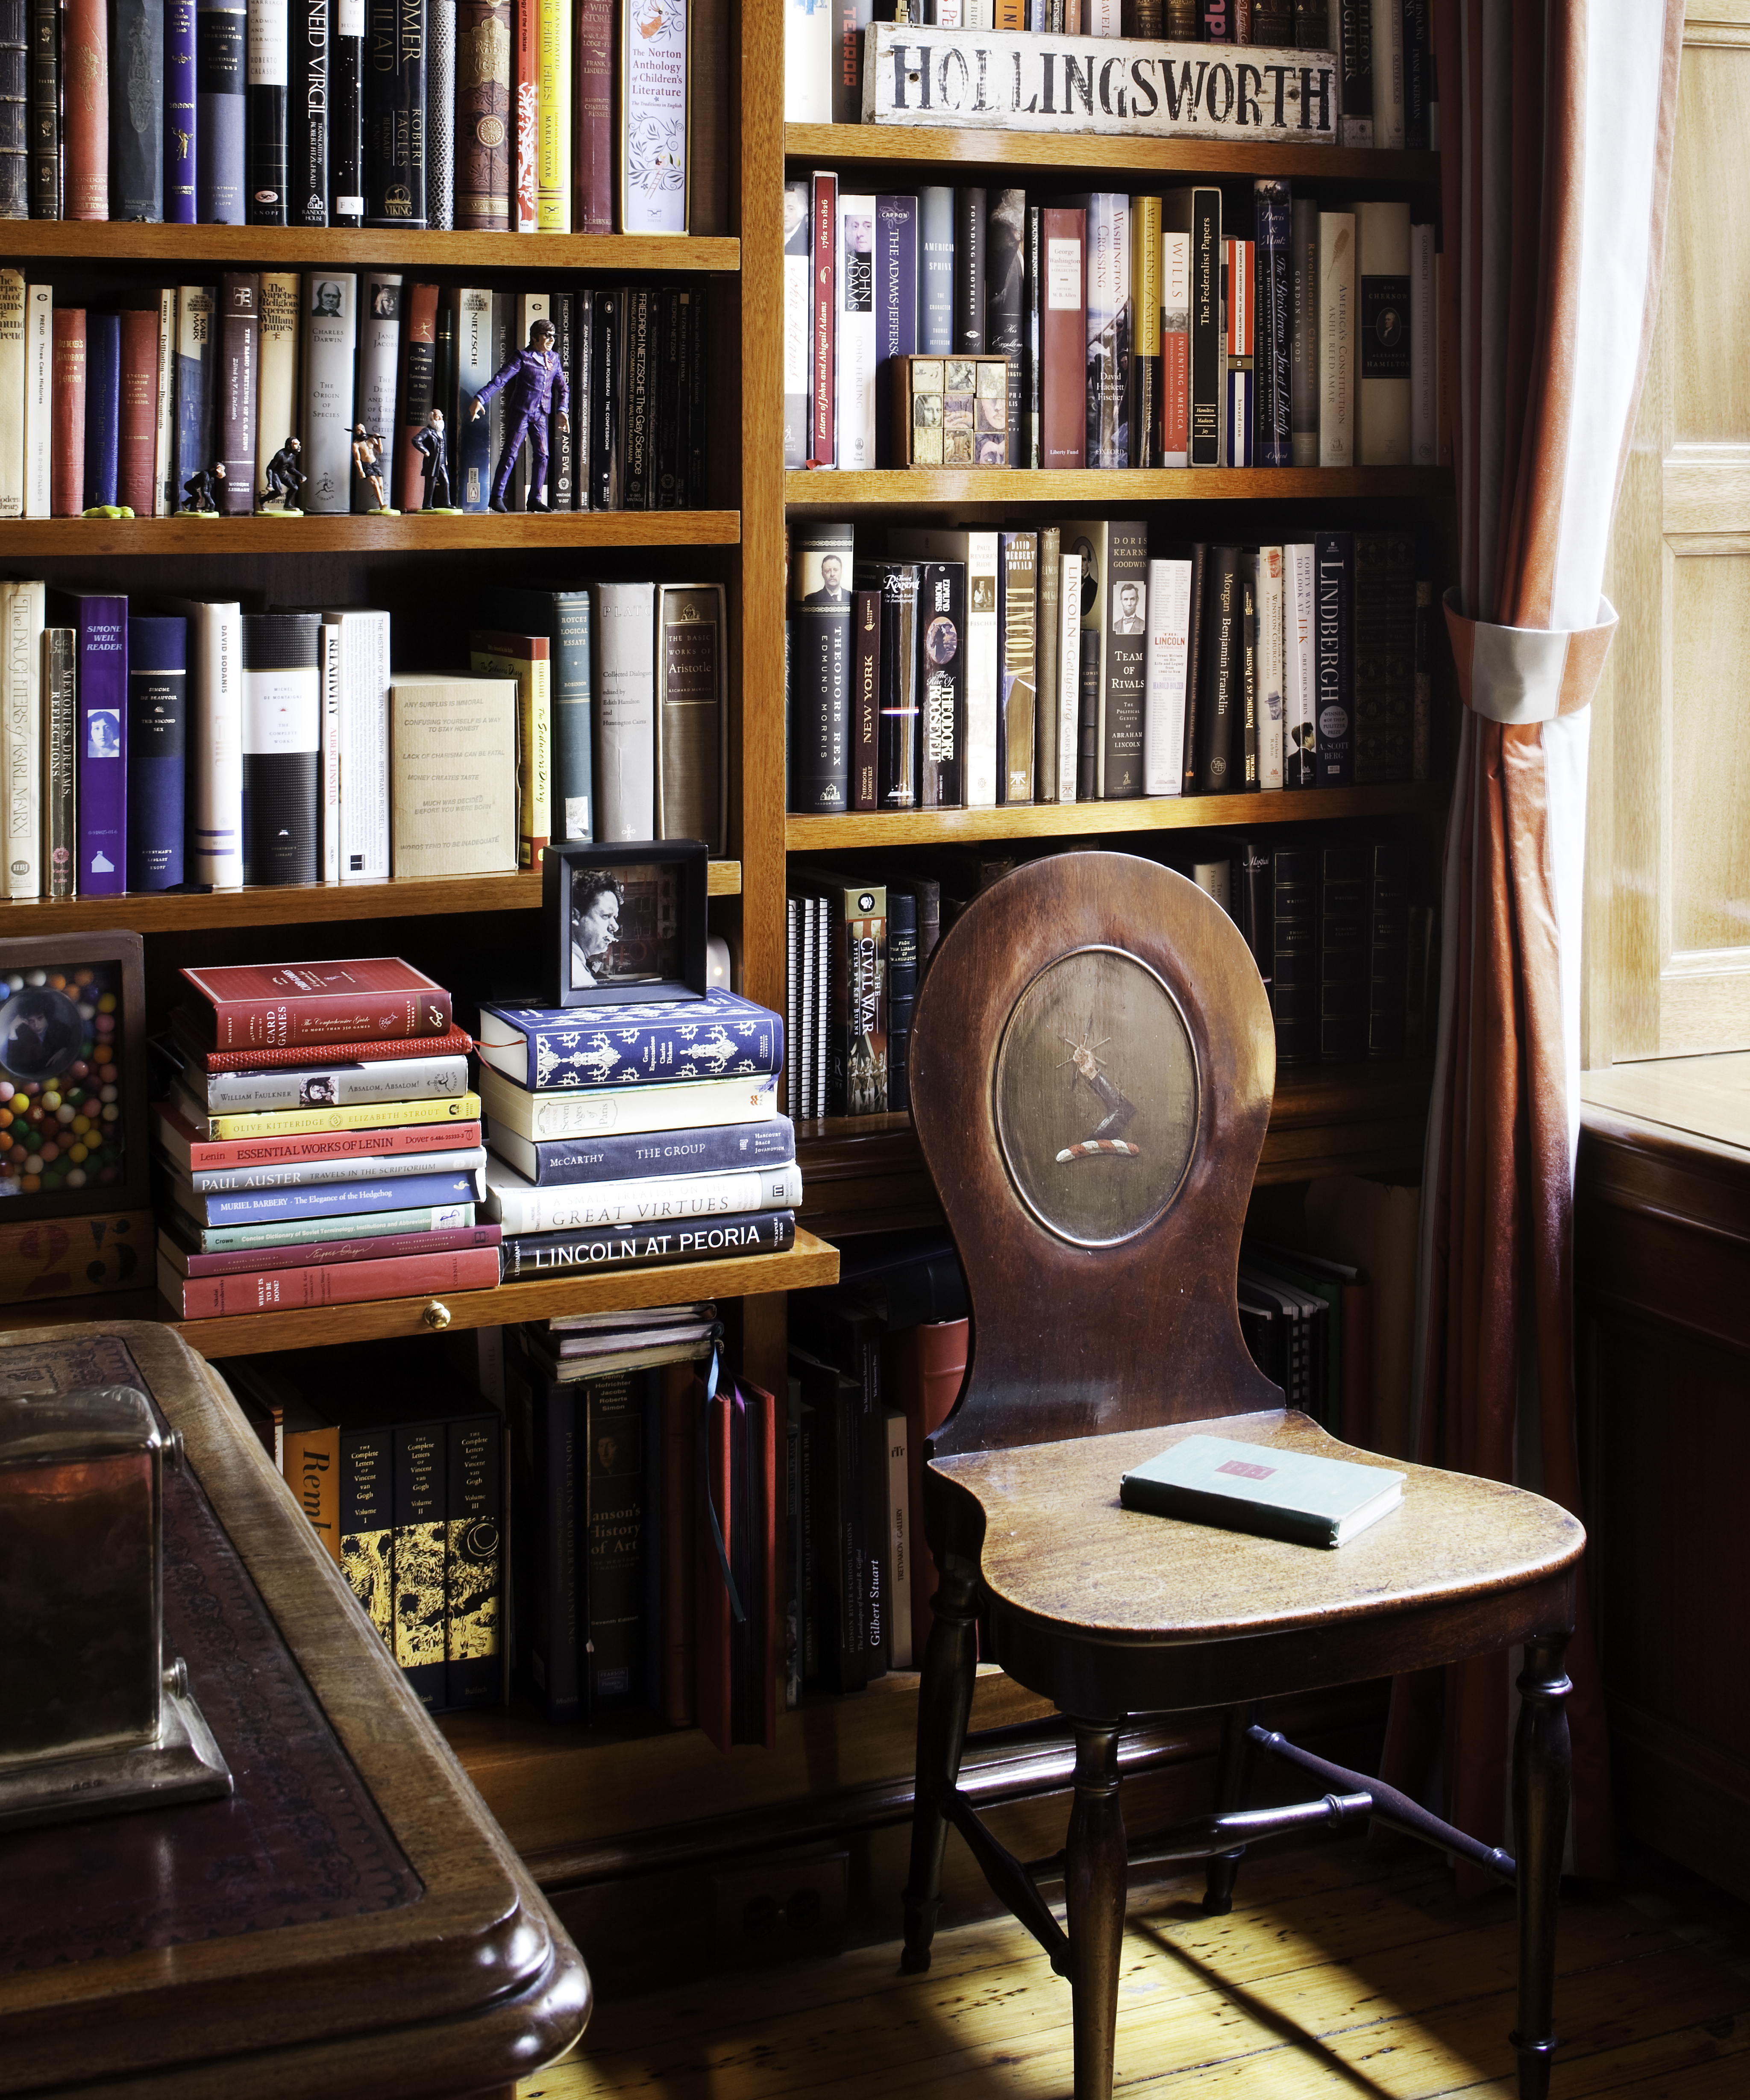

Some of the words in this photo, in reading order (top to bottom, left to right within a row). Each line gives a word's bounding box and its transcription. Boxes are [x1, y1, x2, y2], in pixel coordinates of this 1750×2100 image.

[648, 47, 681, 59] Norton
[843, 6, 856, 86] TERROR
[633, 60, 681, 73] Anthology
[640, 73, 682, 84] Children's
[308, 54, 325, 119] VIRGIL
[632, 85, 681, 96] Literature
[890, 43, 1331, 131] HOLLINGSWORTH
[398, 111, 408, 167] FAGLES
[411, 109, 421, 168] ROBERT
[385, 205, 412, 216] VIKING
[822, 219, 828, 229] TO
[1201, 217, 1212, 250] Papers
[847, 255, 859, 310] ADAMS
[858, 261, 870, 303] JOHN
[1172, 242, 1183, 298] WILLS
[1201, 253, 1210, 304] Federalist
[374, 341, 398, 349] JACOBS
[819, 334, 828, 365] Abigail
[638, 343, 646, 396] NIETZSCHE
[636, 396, 645, 414] The
[818, 384, 827, 402] John
[818, 403, 827, 413] of
[634, 415, 645, 435] Gay
[818, 415, 827, 440] Letters
[635, 436, 644, 474] Science
[1220, 573, 1233, 612] Morgan
[603, 605, 653, 617] PLATO
[1004, 587, 1034, 676] LINCOLN
[1154, 637, 1185, 645] LINCOLN
[1220, 617, 1231, 668] Benjamin
[1320, 560, 1344, 702] LINDBERGH
[668, 662, 712, 673] Aristotle
[1115, 652, 1142, 661] TEAM
[1124, 666, 1135, 675] OF
[329, 638, 338, 716] RELATIVITY
[834, 626, 842, 722] THEODORE
[863, 655, 873, 704] YORK
[1112, 678, 1145, 688] RIVALS
[1218, 672, 1229, 715] Franklin
[1247, 685, 1253, 694] AS
[863, 706, 872, 743] NEW
[929, 685, 941, 762] ROOSEVELT
[942, 685, 954, 760] THEODORE
[860, 937, 874, 991] CIVIL
[267, 1010, 276, 1044] CARD
[278, 1006, 287, 1046] GAMES
[861, 993, 875, 1034] WAR
[220, 1093, 252, 1102] WILLIAM
[254, 1090, 291, 1100] FAULKNER
[385, 1081, 419, 1090] ABSALOM!
[233, 1124, 262, 1132] OLIVE
[266, 1119, 324, 1129] KITTERIDGE
[348, 1111, 400, 1123] ELIZABETH
[403, 1109, 440, 1119] STROUT
[200, 1152, 225, 1160] Lenin
[237, 1145, 300, 1160] ESSENTIAL
[301, 1143, 341, 1156] WORKS
[342, 1141, 357, 1151] OF
[358, 1138, 393, 1149] LENIN
[405, 1135, 429, 1144] Dover
[550, 1154, 604, 1167] McCARTHY
[636, 1148, 661, 1159] THE
[664, 1143, 706, 1157] GROUP
[202, 1178, 239, 1191] PAUL
[245, 1172, 301, 1187] AUSTER
[220, 1201, 252, 1211] MURIEL
[253, 1197, 288, 1209] BARBERY
[295, 1195, 308, 1205] The
[309, 1192, 338, 1204] Elegance
[339, 1192, 346, 1201] of
[348, 1191, 358, 1200] the
[359, 1188, 392, 1200] Hedgehog
[552, 1206, 625, 1225] GREAT
[636, 1196, 729, 1218] VIRTUES
[535, 1238, 637, 1268] LINCOLN
[644, 1235, 672, 1254] AT
[679, 1225, 760, 1251] PEORIA
[408, 1442, 435, 1451] Complete
[413, 1483, 429, 1492] Gogh
[870, 1560, 879, 1597] Stuart
[870, 1600, 880, 1646] Gilbert
